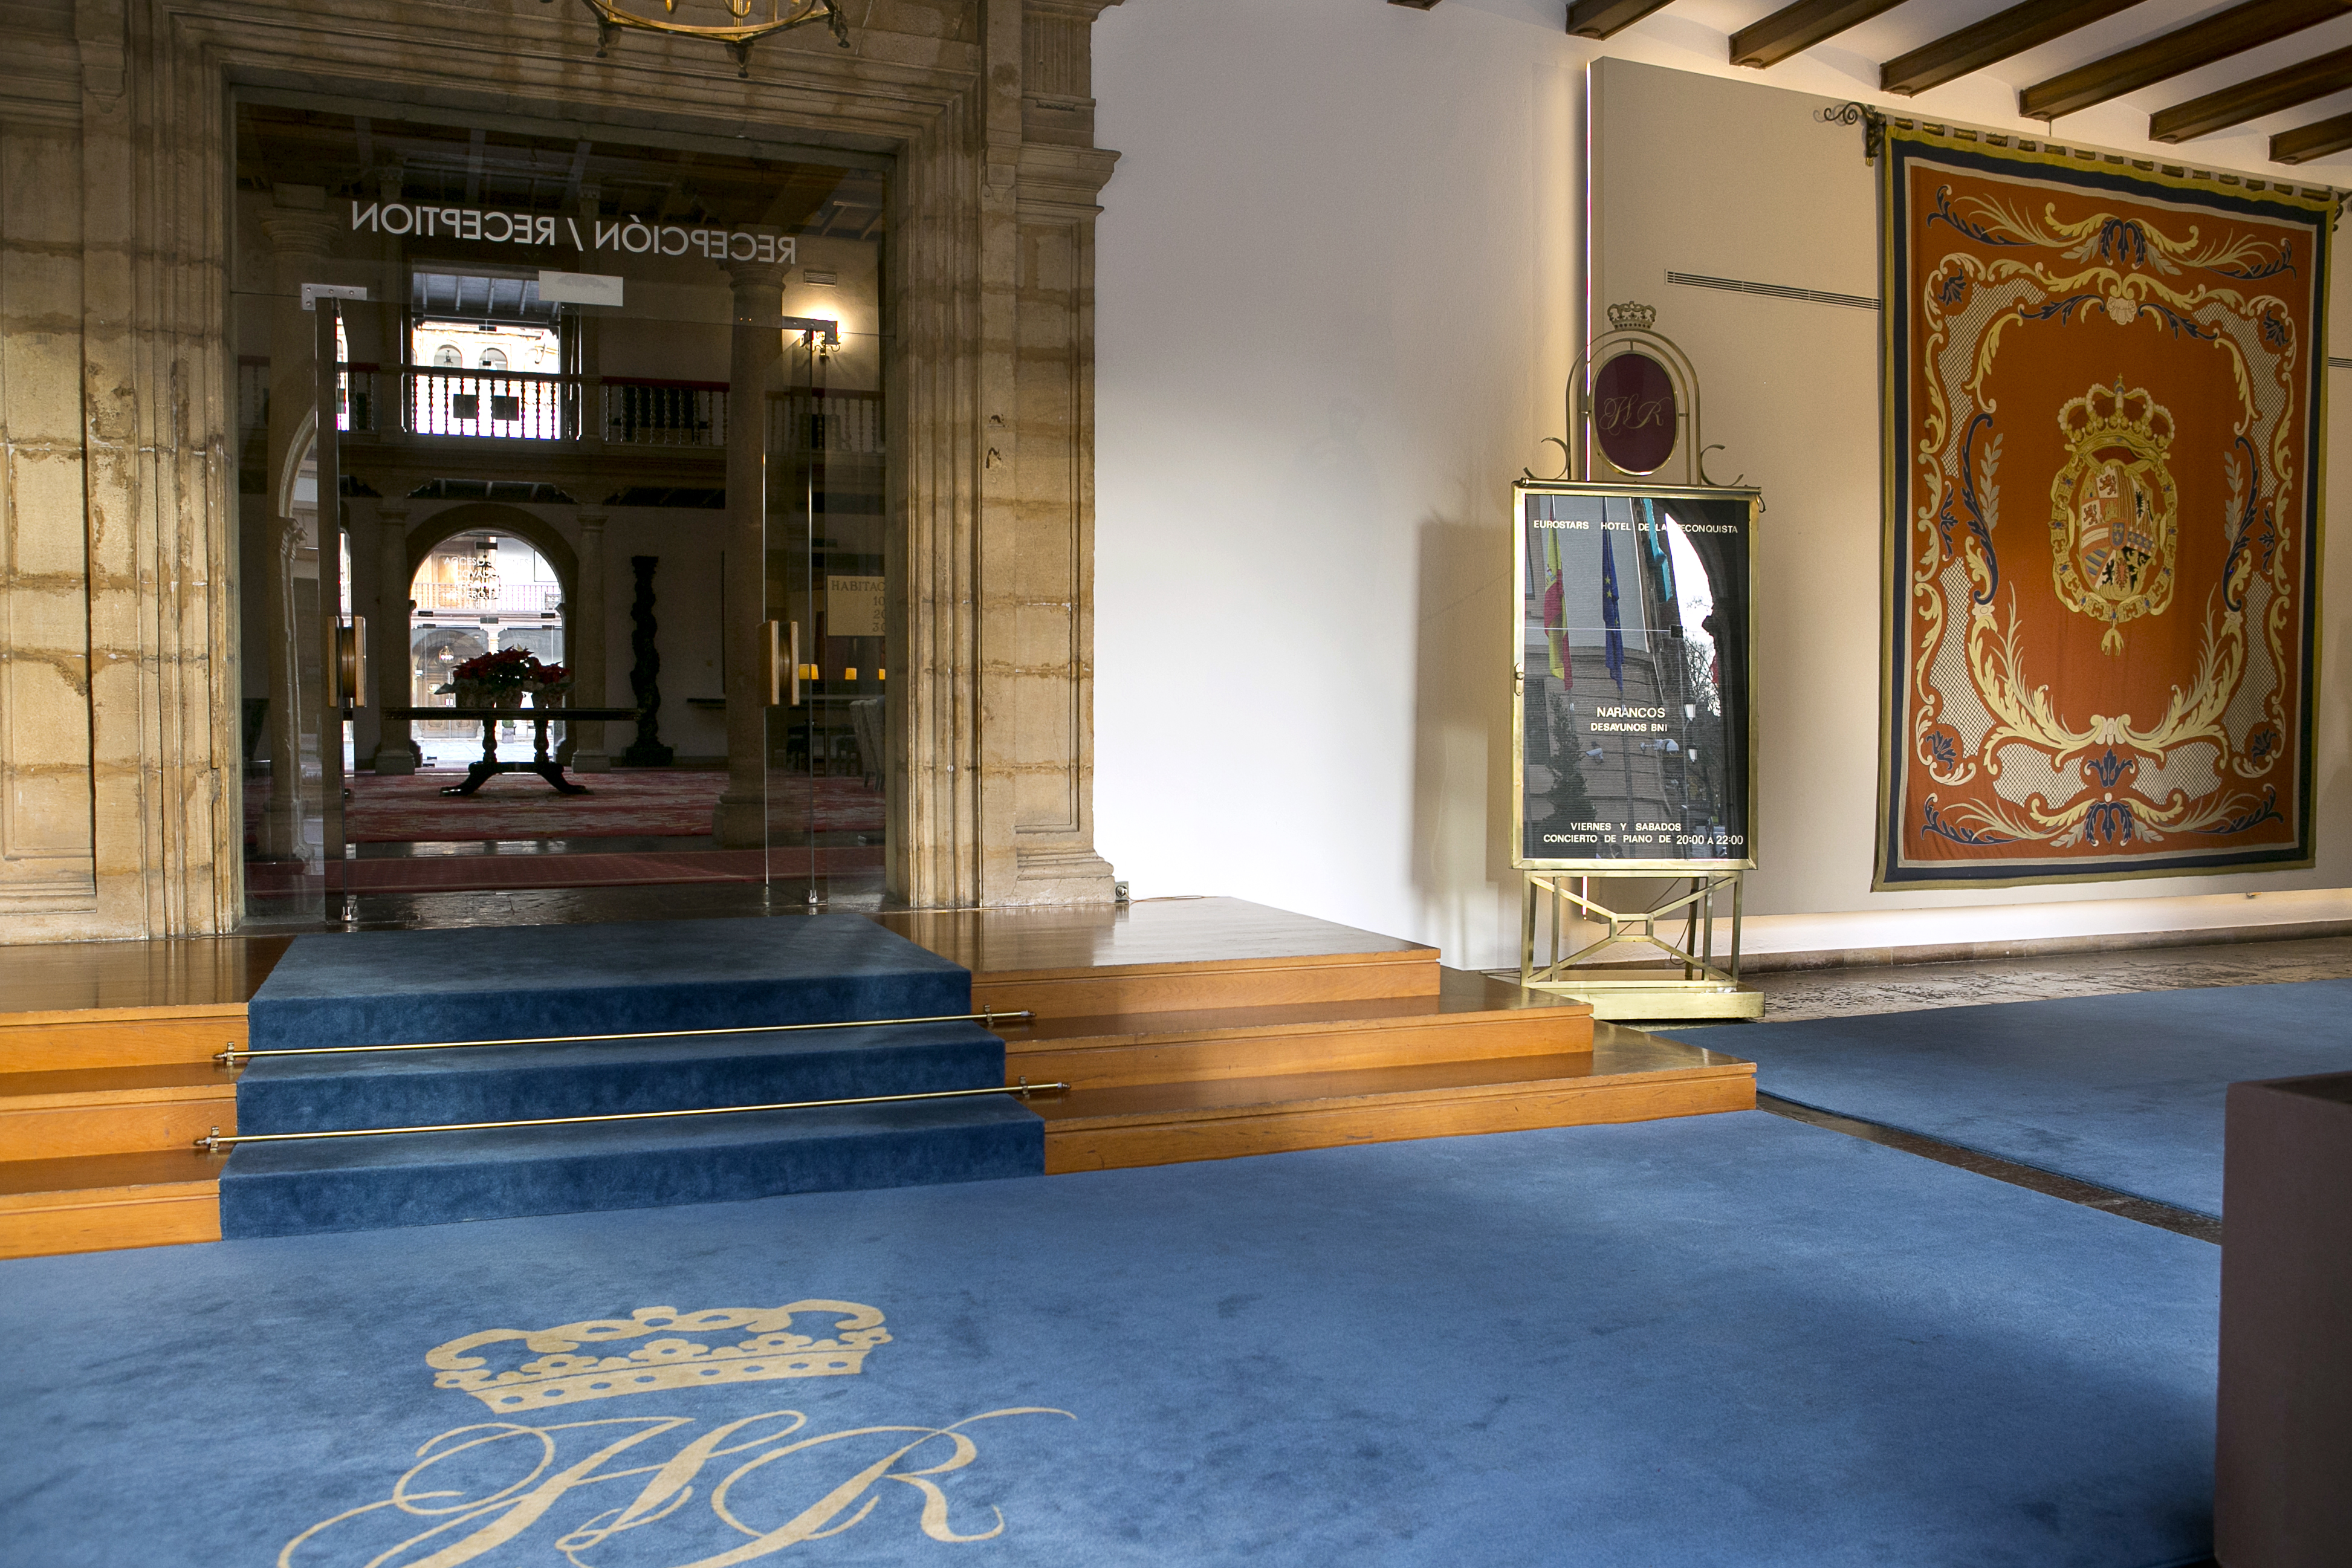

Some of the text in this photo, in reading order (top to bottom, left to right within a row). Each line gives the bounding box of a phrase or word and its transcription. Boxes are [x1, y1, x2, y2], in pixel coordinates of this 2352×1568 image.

[1534, 520, 1738, 533] EUROSTARS HOTEL DE LA ECONQUISTA
[1596, 707, 1665, 718] NARANCOS
[1590, 723, 1668, 732] DESAYUNOS BNI
[1635, 823, 1682, 831] SABADOS
[1623, 835, 1653, 843] PIANO
[1659, 835, 1671, 843] DE
[1676, 835, 1705, 845] 20:00
[1716, 835, 1743, 845] 22:00
